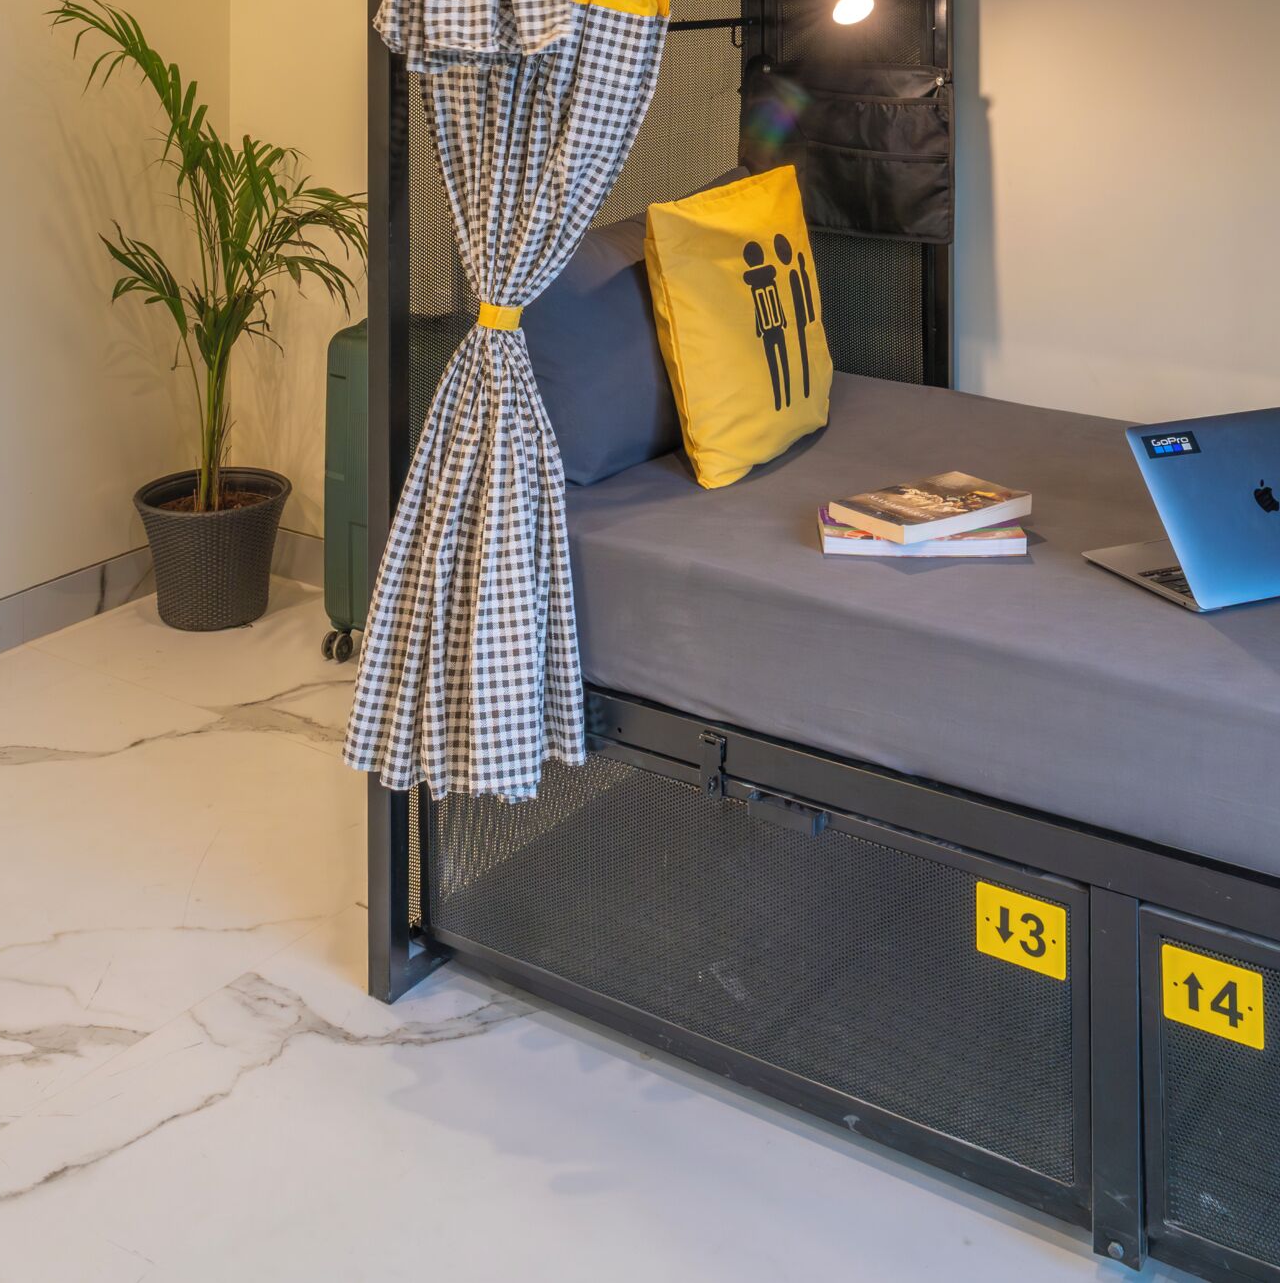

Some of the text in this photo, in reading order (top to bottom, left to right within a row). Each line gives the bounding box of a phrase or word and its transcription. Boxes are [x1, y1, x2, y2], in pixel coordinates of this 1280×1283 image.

[1151, 436, 1189, 447] GoPro
[1019, 913, 1047, 958] 3
[1210, 980, 1244, 1029] 4
